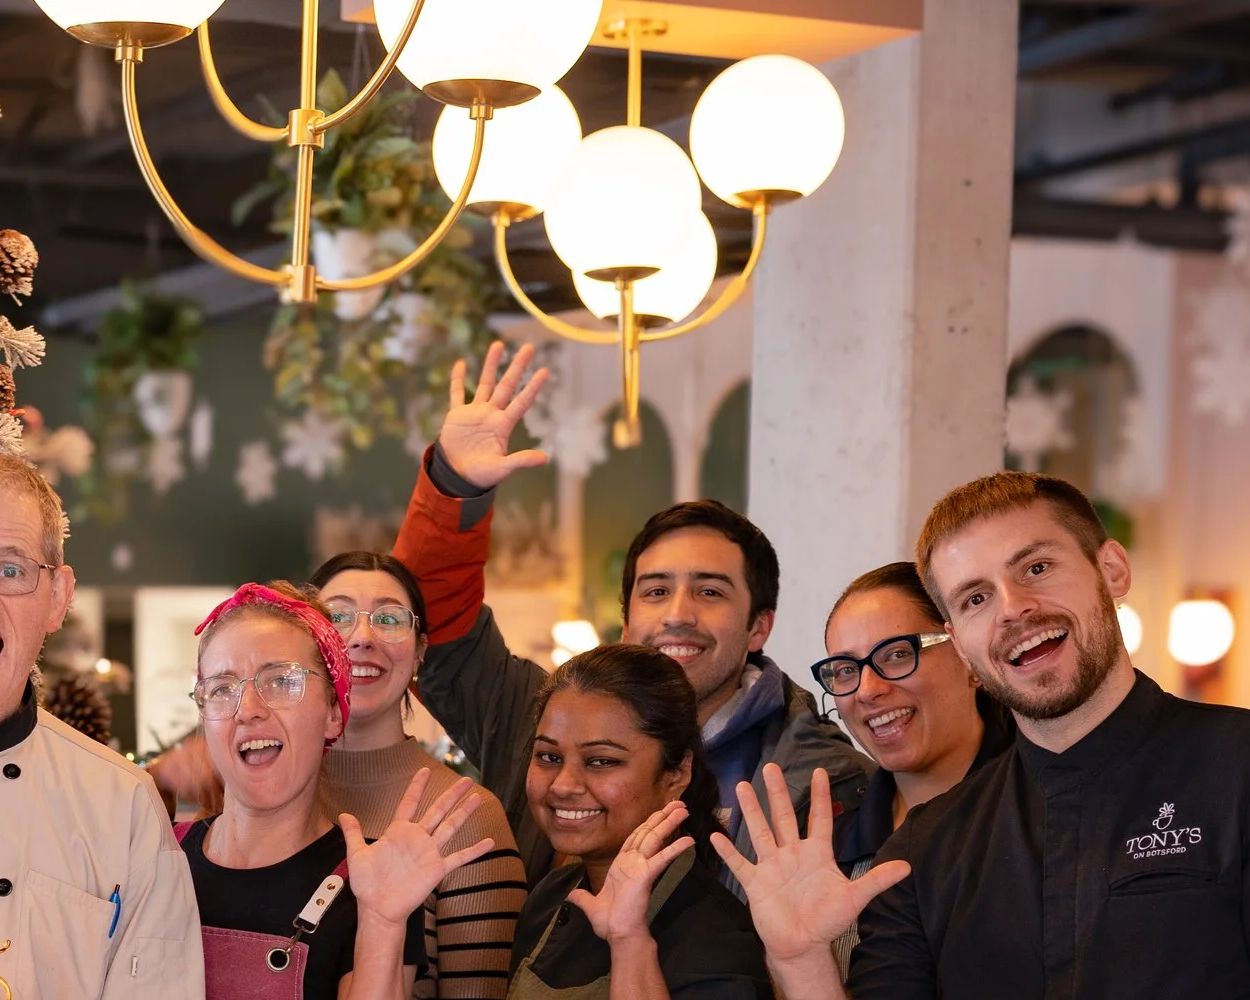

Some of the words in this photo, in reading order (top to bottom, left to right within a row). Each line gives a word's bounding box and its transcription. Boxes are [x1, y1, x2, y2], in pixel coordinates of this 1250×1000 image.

[1126, 827, 1202, 854] TONY'S
[1133, 852, 1145, 860] ON
[1146, 846, 1187, 858] BOTSFORD
